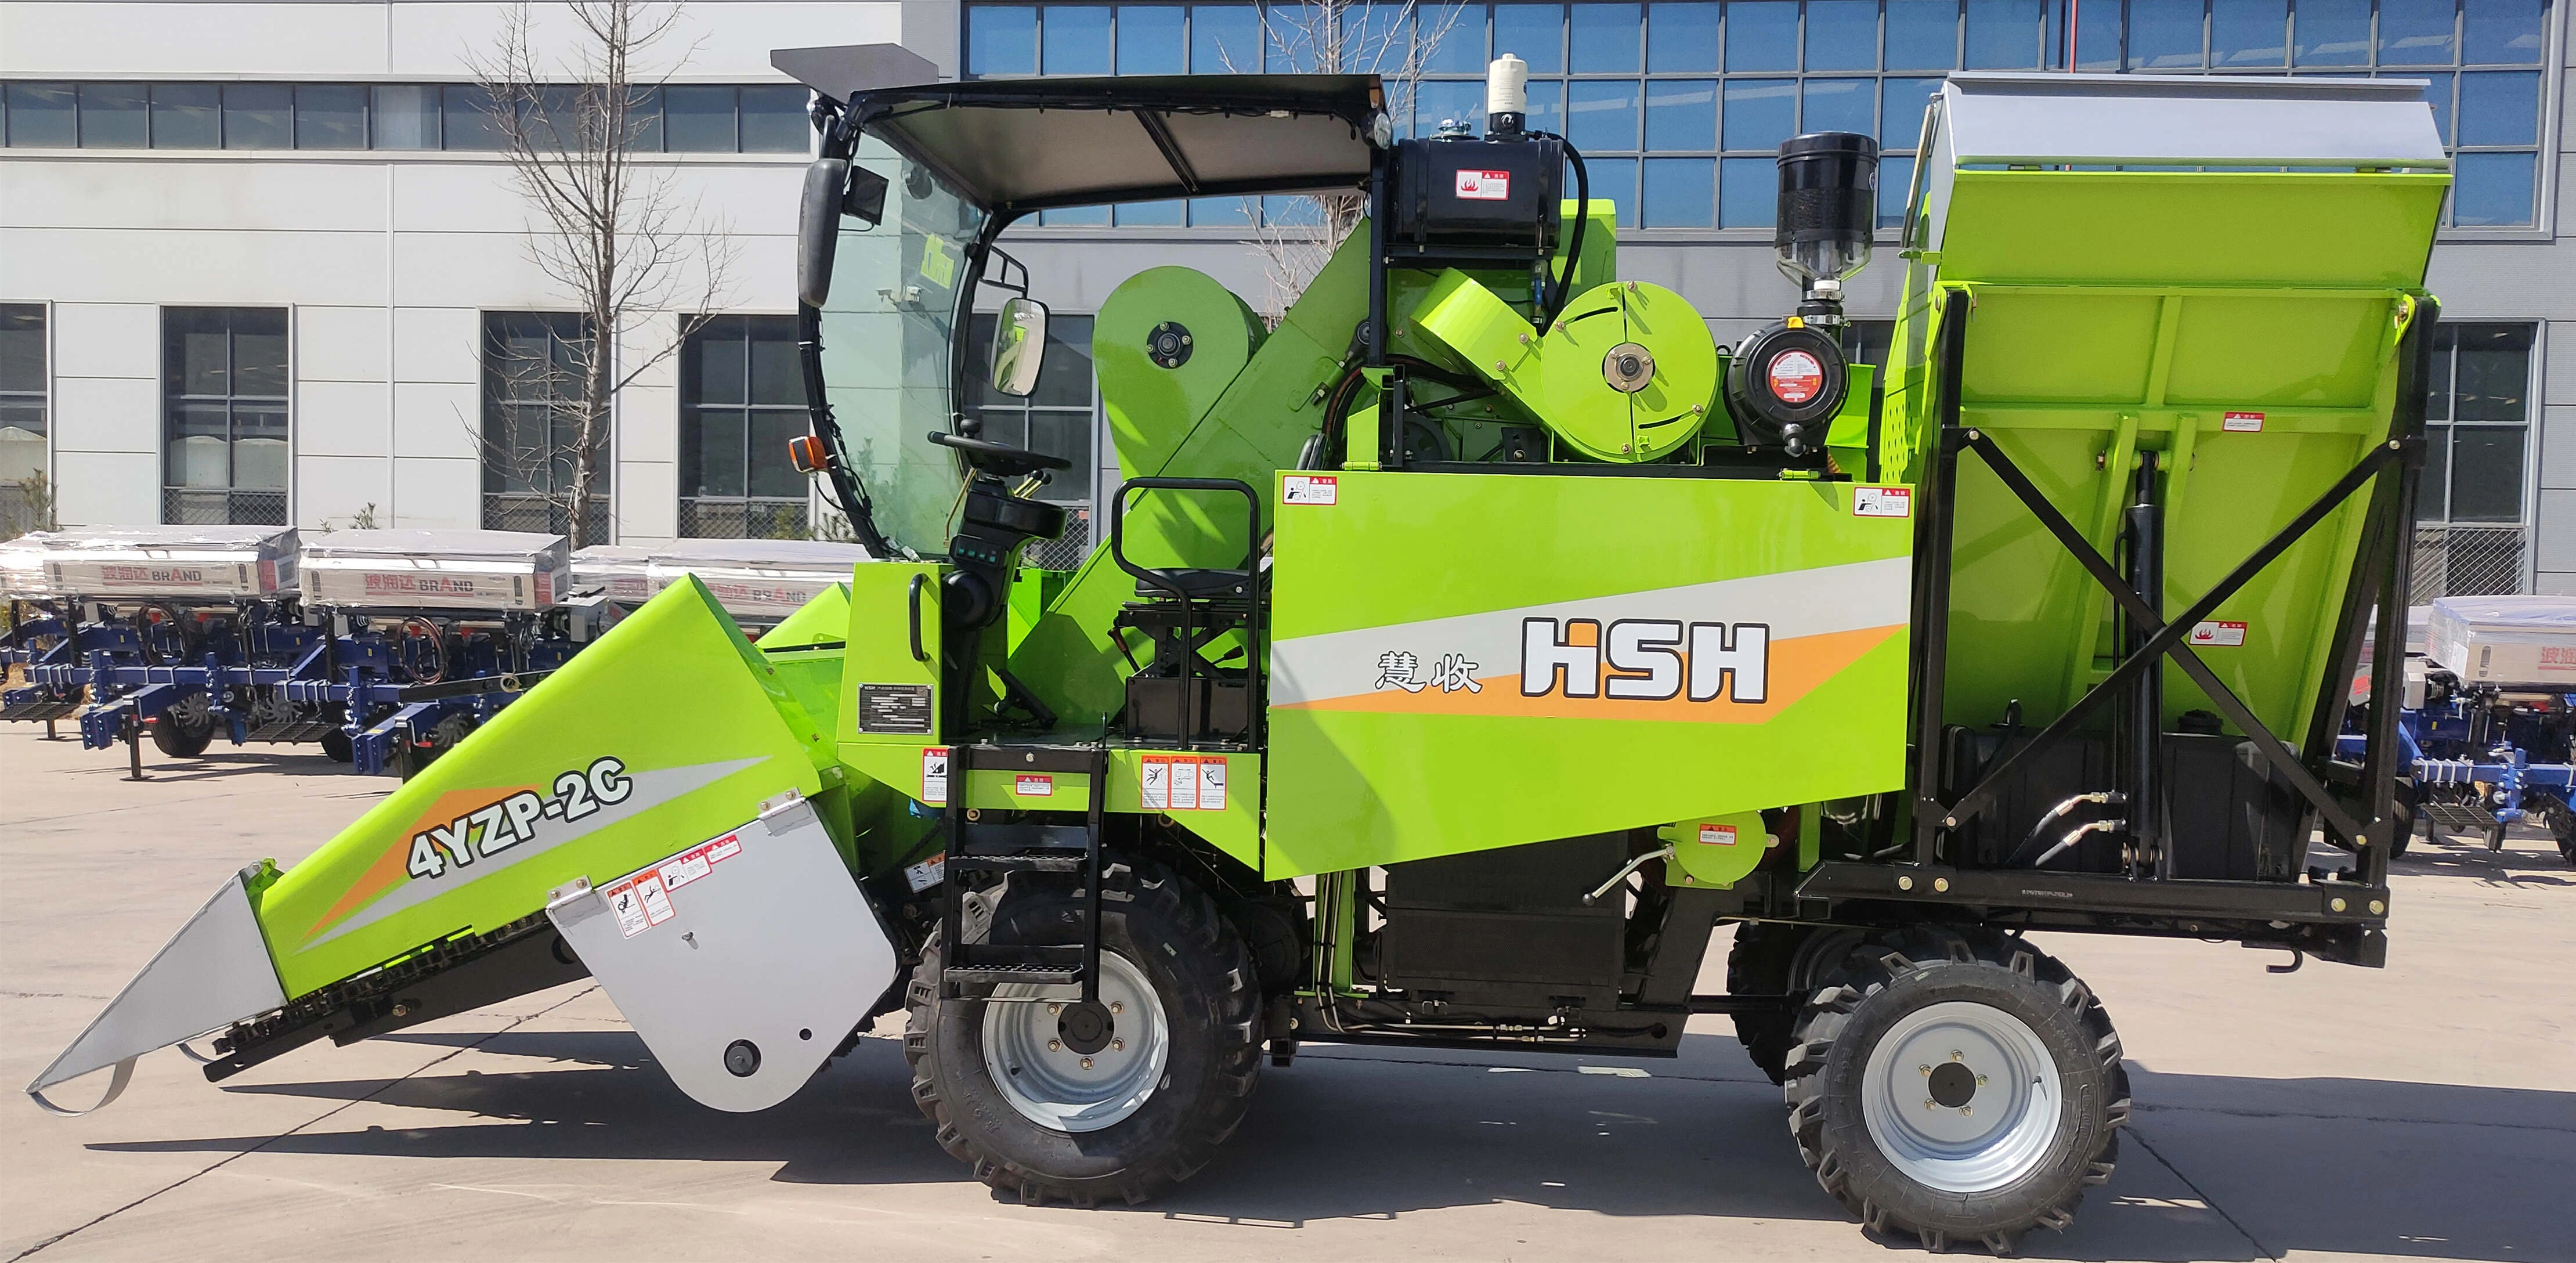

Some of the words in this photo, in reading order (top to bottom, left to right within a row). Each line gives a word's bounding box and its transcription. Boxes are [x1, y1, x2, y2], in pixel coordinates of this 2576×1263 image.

[151, 568, 202, 581] BRAND
[419, 576, 474, 592] BRAND
[753, 587, 807, 603] BRAND
[1375, 651, 1483, 694] 慧收
[1520, 618, 1769, 703] HSH
[406, 756, 633, 879] 4YZP-2C
